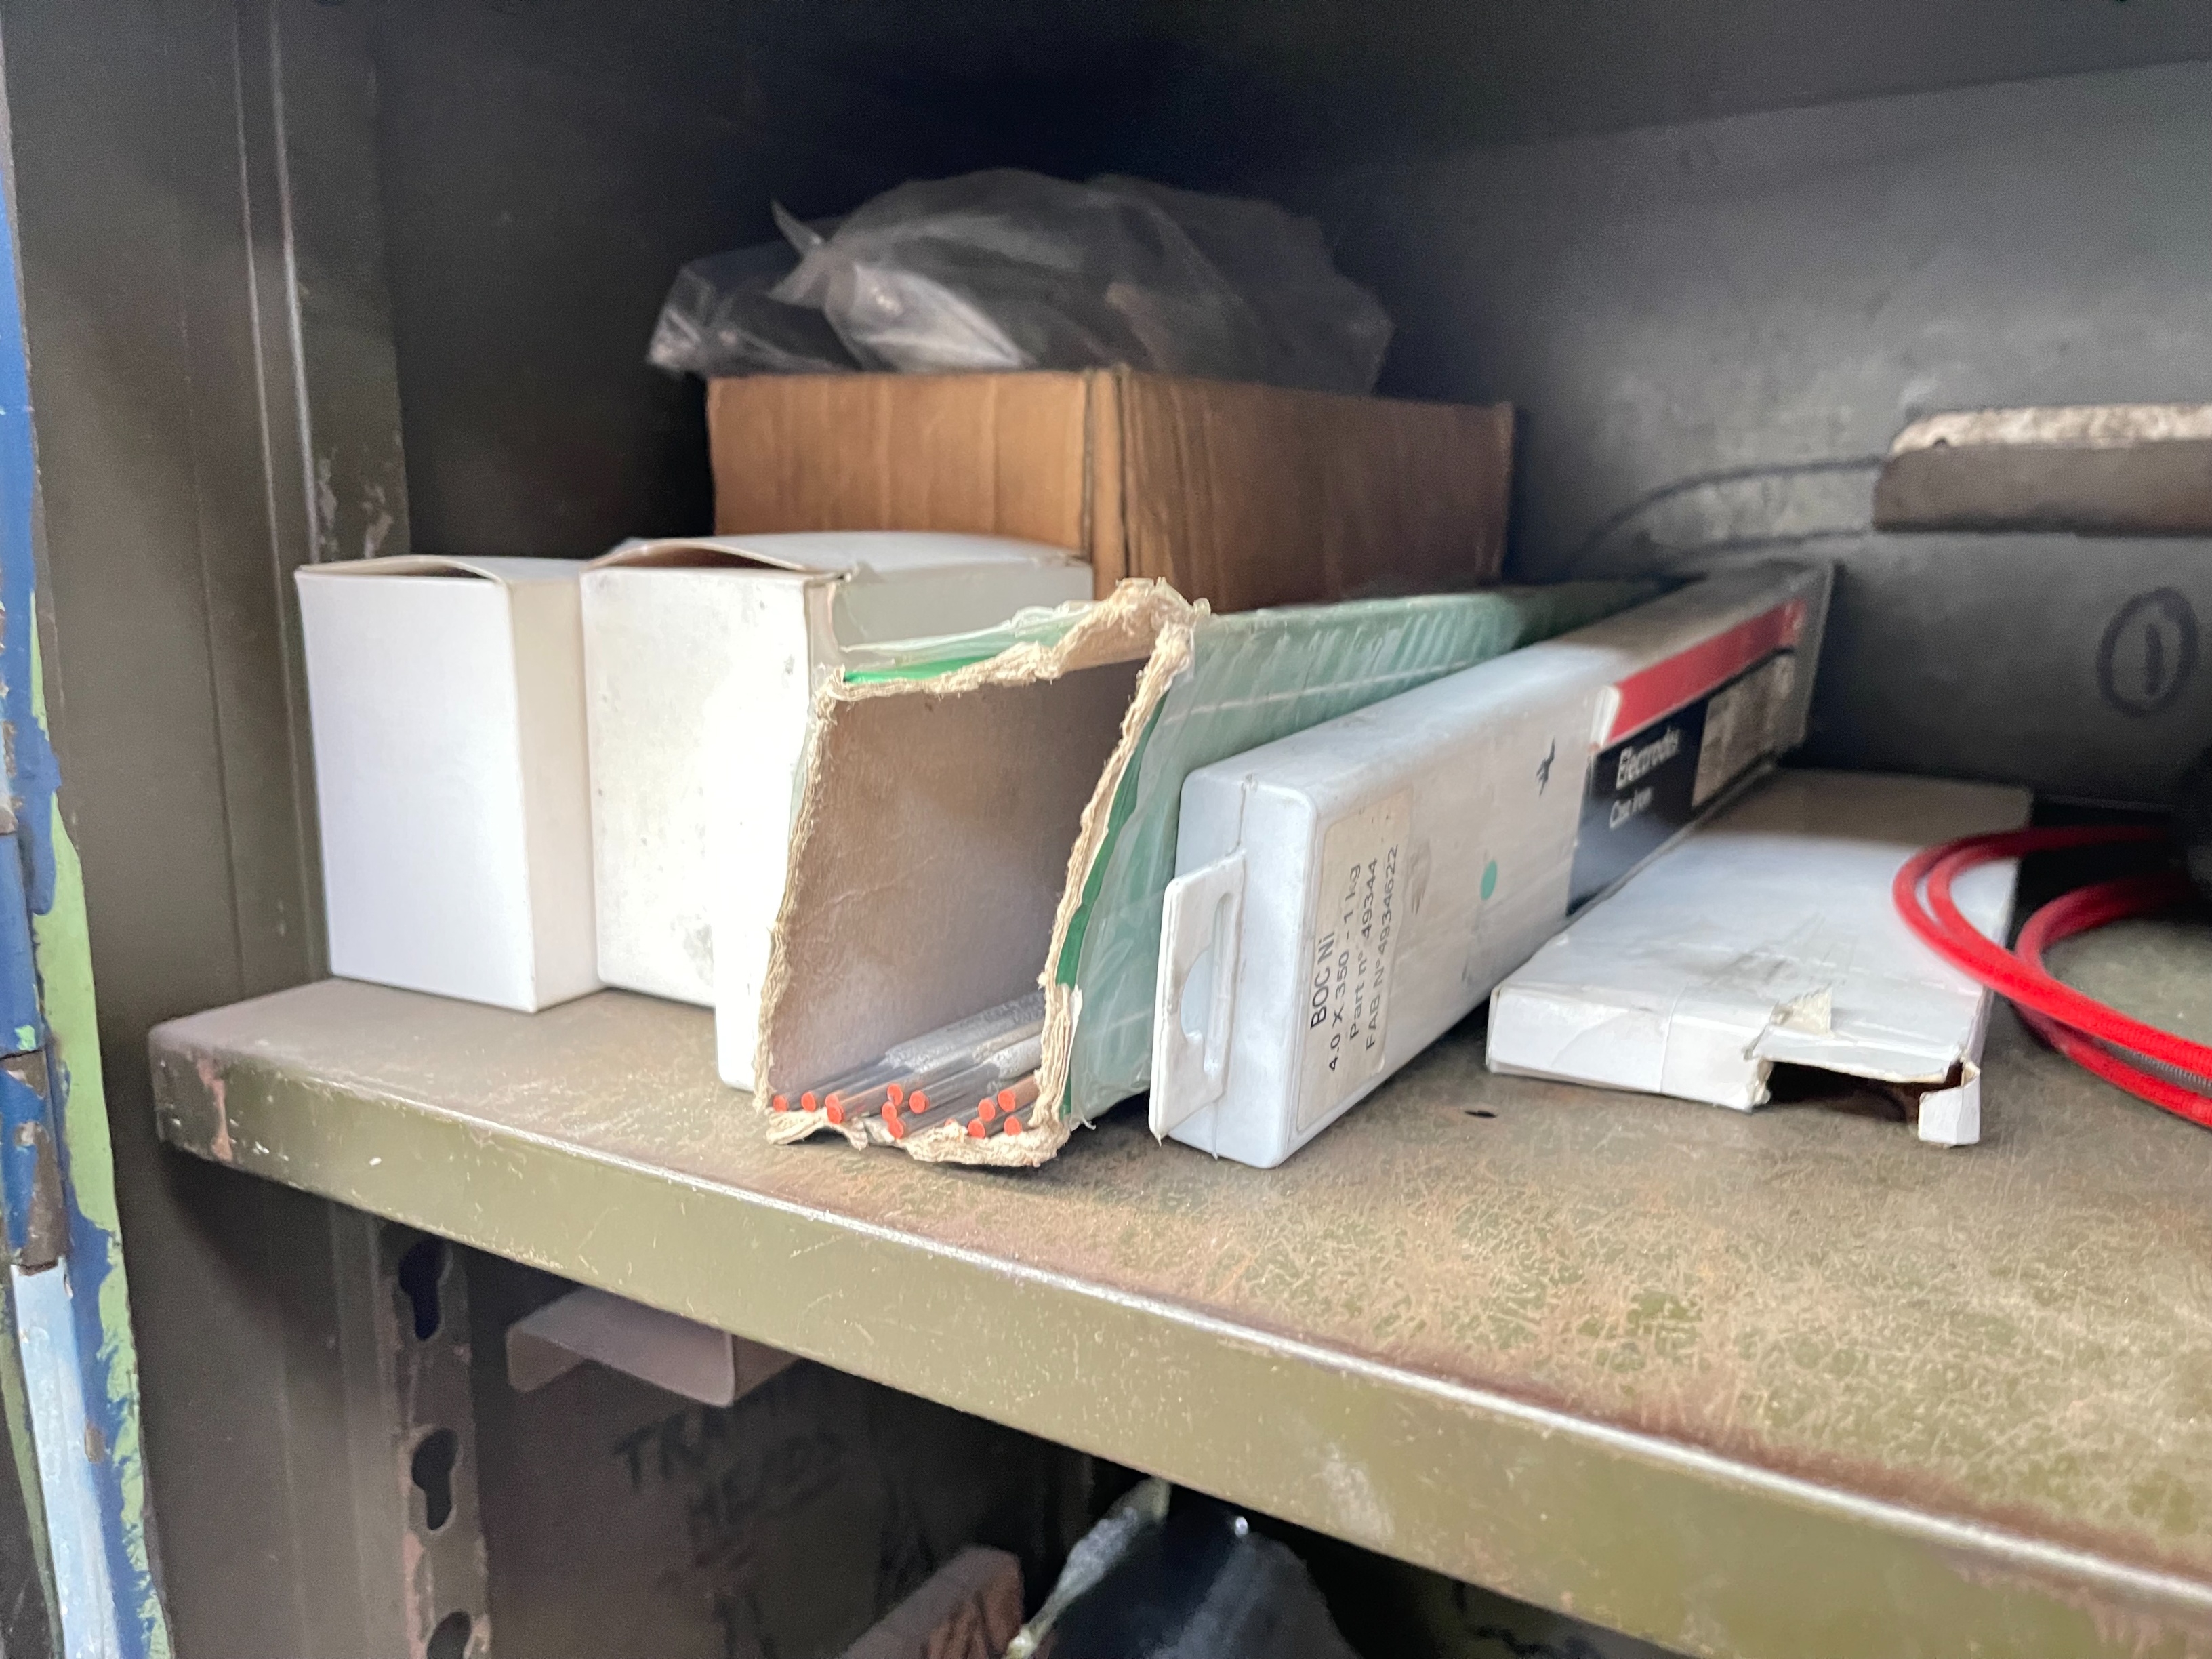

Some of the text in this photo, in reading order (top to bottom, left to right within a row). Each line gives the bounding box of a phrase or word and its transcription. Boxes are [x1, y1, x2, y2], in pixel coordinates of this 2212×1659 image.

[1345, 863, 1361, 903] kg
[1344, 909, 1353, 925] 1
[1349, 980, 1365, 1041] Part
[1361, 857, 1378, 940] 49344
[1310, 930, 1335, 1030] BOC Ni
[1335, 950, 1349, 1000] 350
[1328, 1033, 1341, 1071] 4.0
